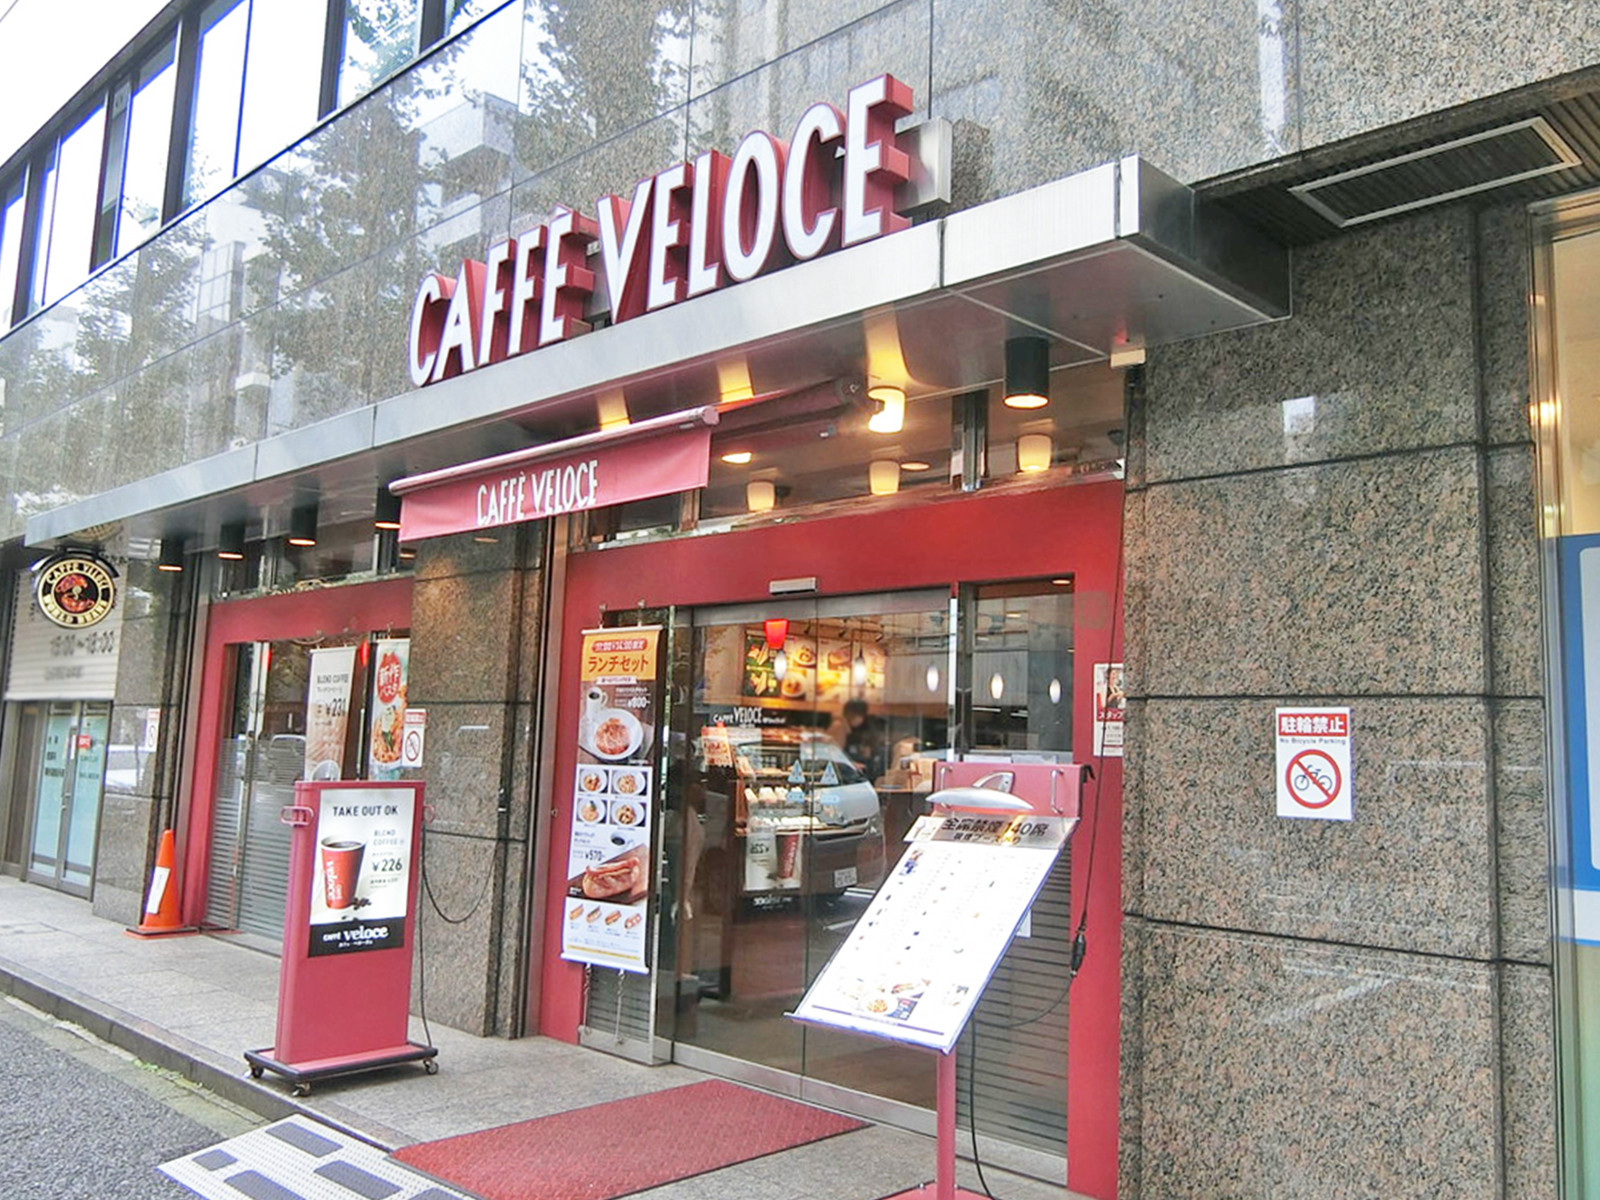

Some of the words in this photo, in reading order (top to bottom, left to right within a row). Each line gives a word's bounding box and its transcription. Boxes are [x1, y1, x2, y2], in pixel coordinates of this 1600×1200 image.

[408, 205, 582, 387] CAFFÈ
[598, 73, 902, 325] VELOCE
[477, 471, 526, 526] CAFFÈ
[531, 460, 598, 516] VELOCE
[588, 654, 648, 673] ランチセット
[1281, 716, 1345, 733] 駐輪禁止
[1319, 738, 1347, 746] Parking
[332, 806, 359, 817] TAKE
[362, 805, 383, 816] OUT
[385, 805, 399, 815] OK
[941, 816, 1001, 834] 全席禁煙
[343, 924, 390, 942] veloce
